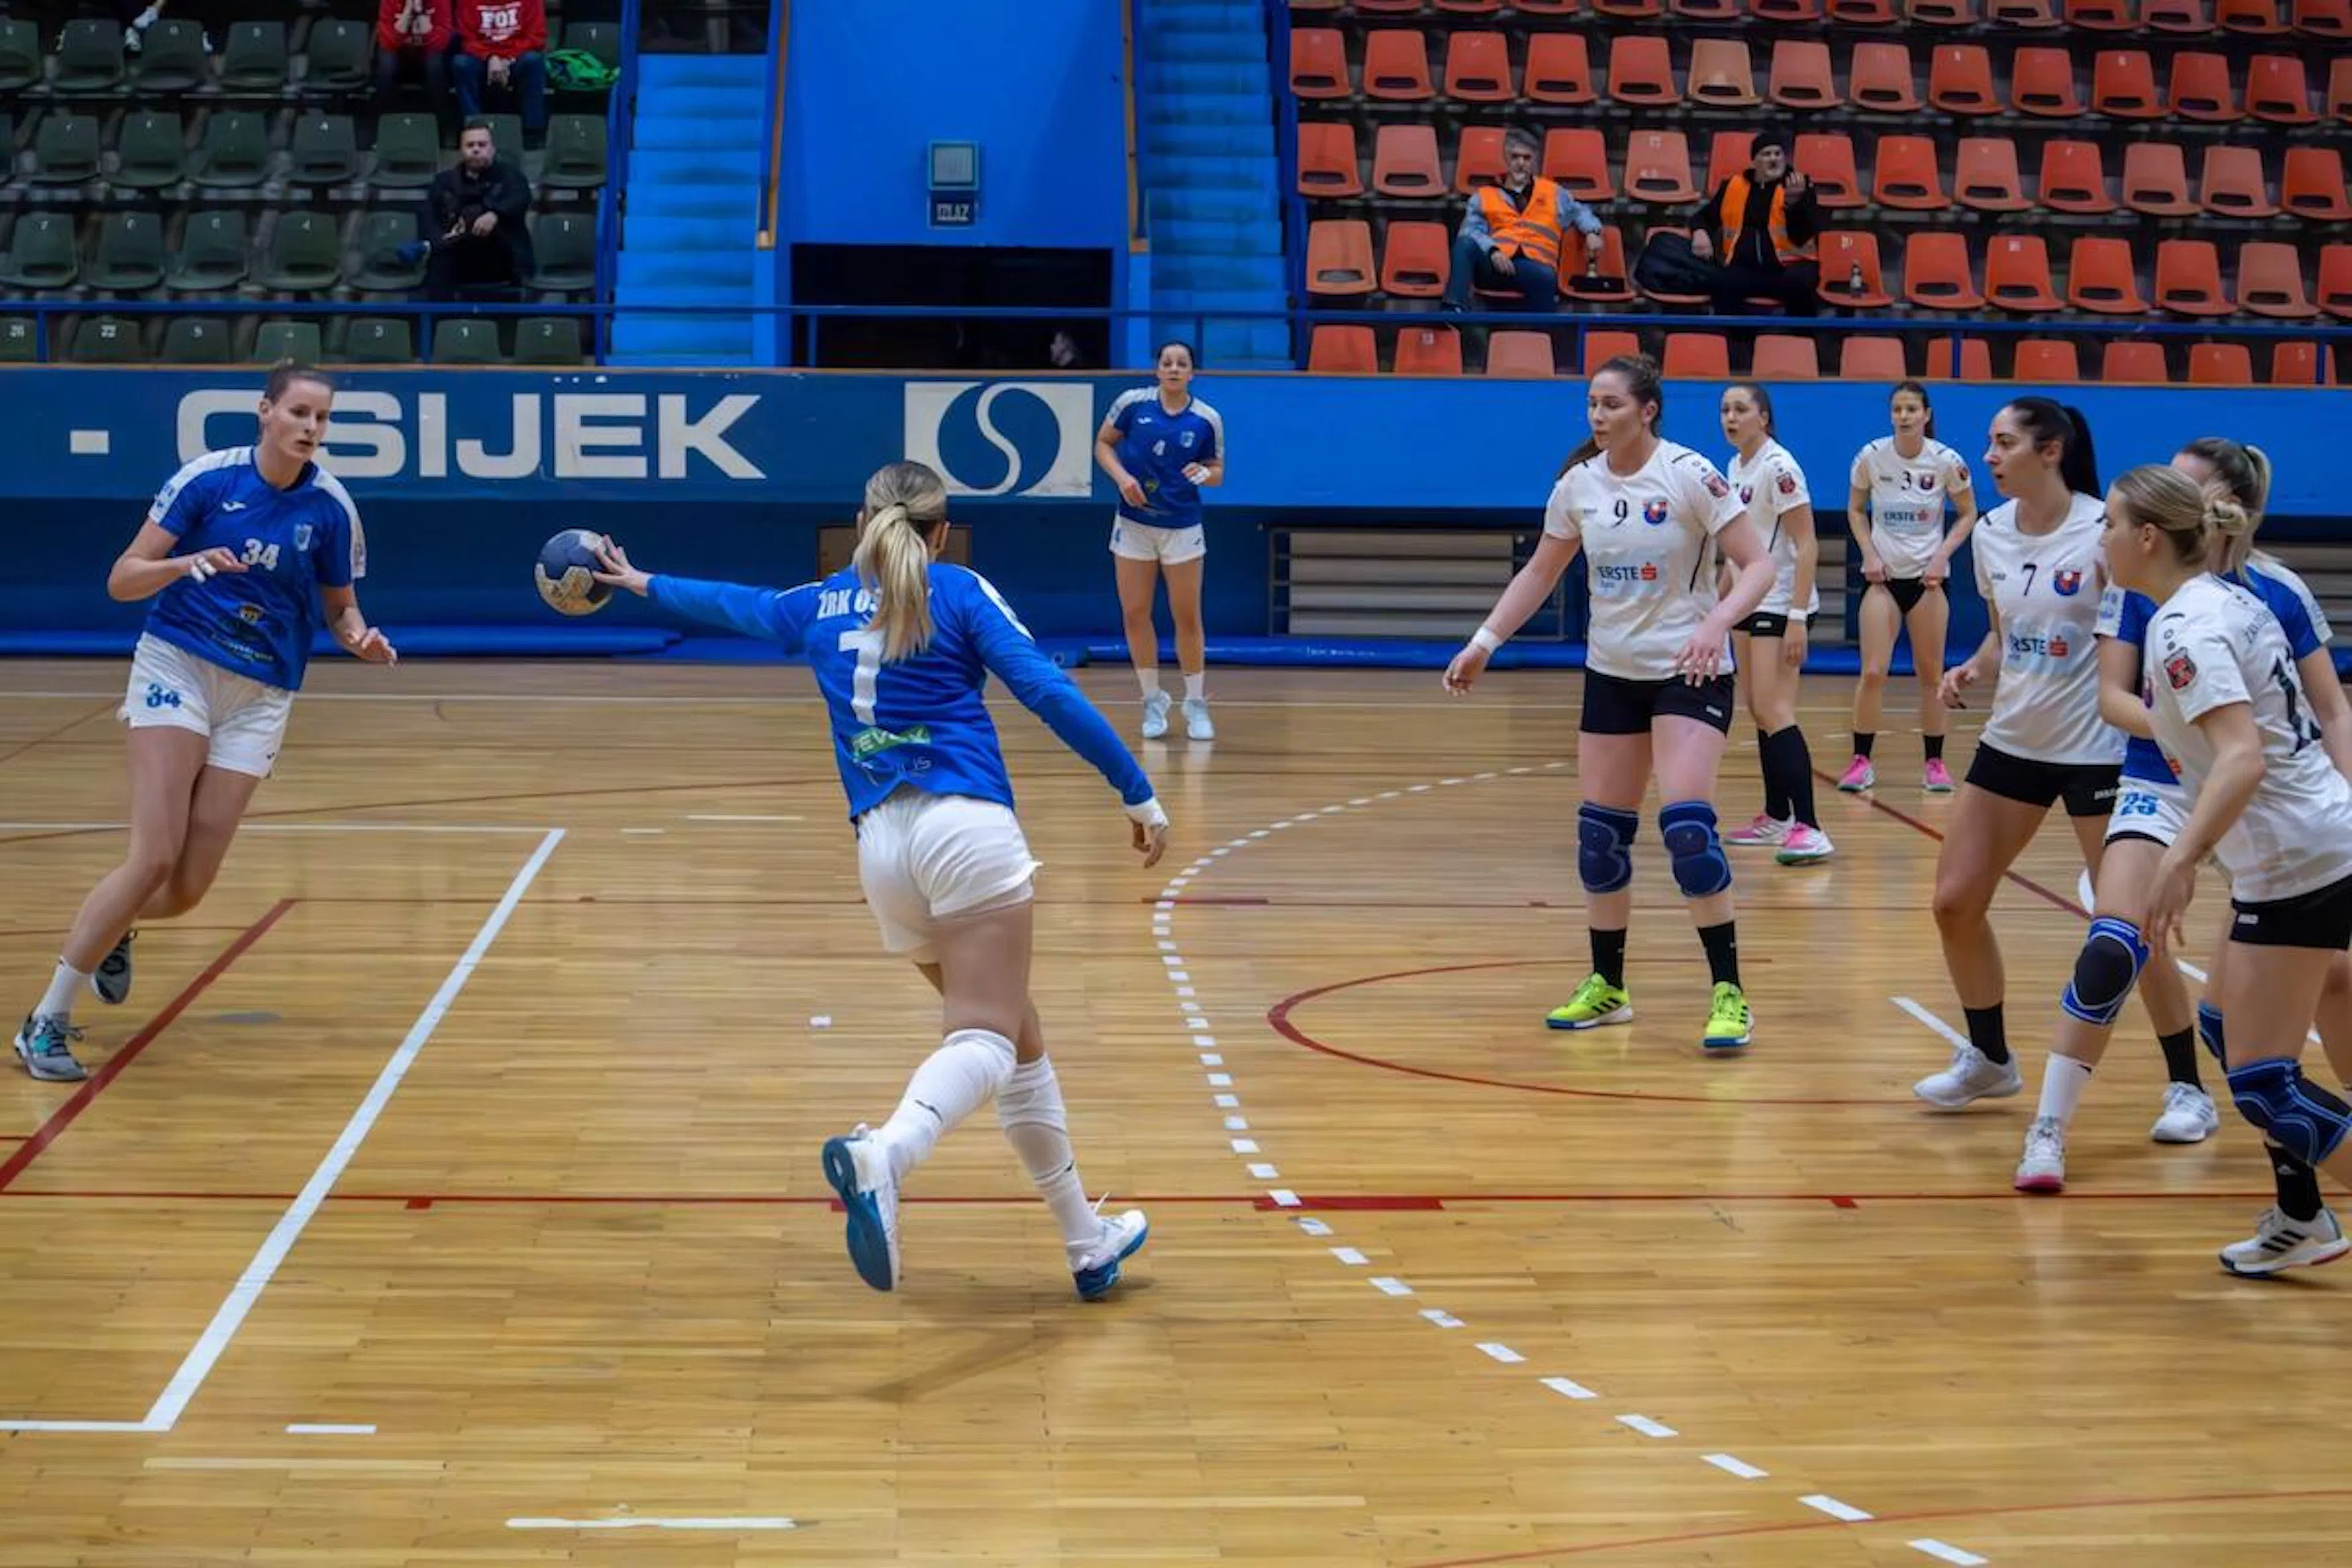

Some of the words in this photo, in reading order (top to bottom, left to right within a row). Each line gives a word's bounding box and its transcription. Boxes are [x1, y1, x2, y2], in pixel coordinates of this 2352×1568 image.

[1152, 439, 1166, 456] 4
[1901, 469, 1912, 491] 3
[1611, 499, 1629, 528] 9
[241, 538, 281, 571] 34
[2021, 563, 2038, 597] 7
[145, 682, 183, 709] 34
[2120, 791, 2159, 816] 25
